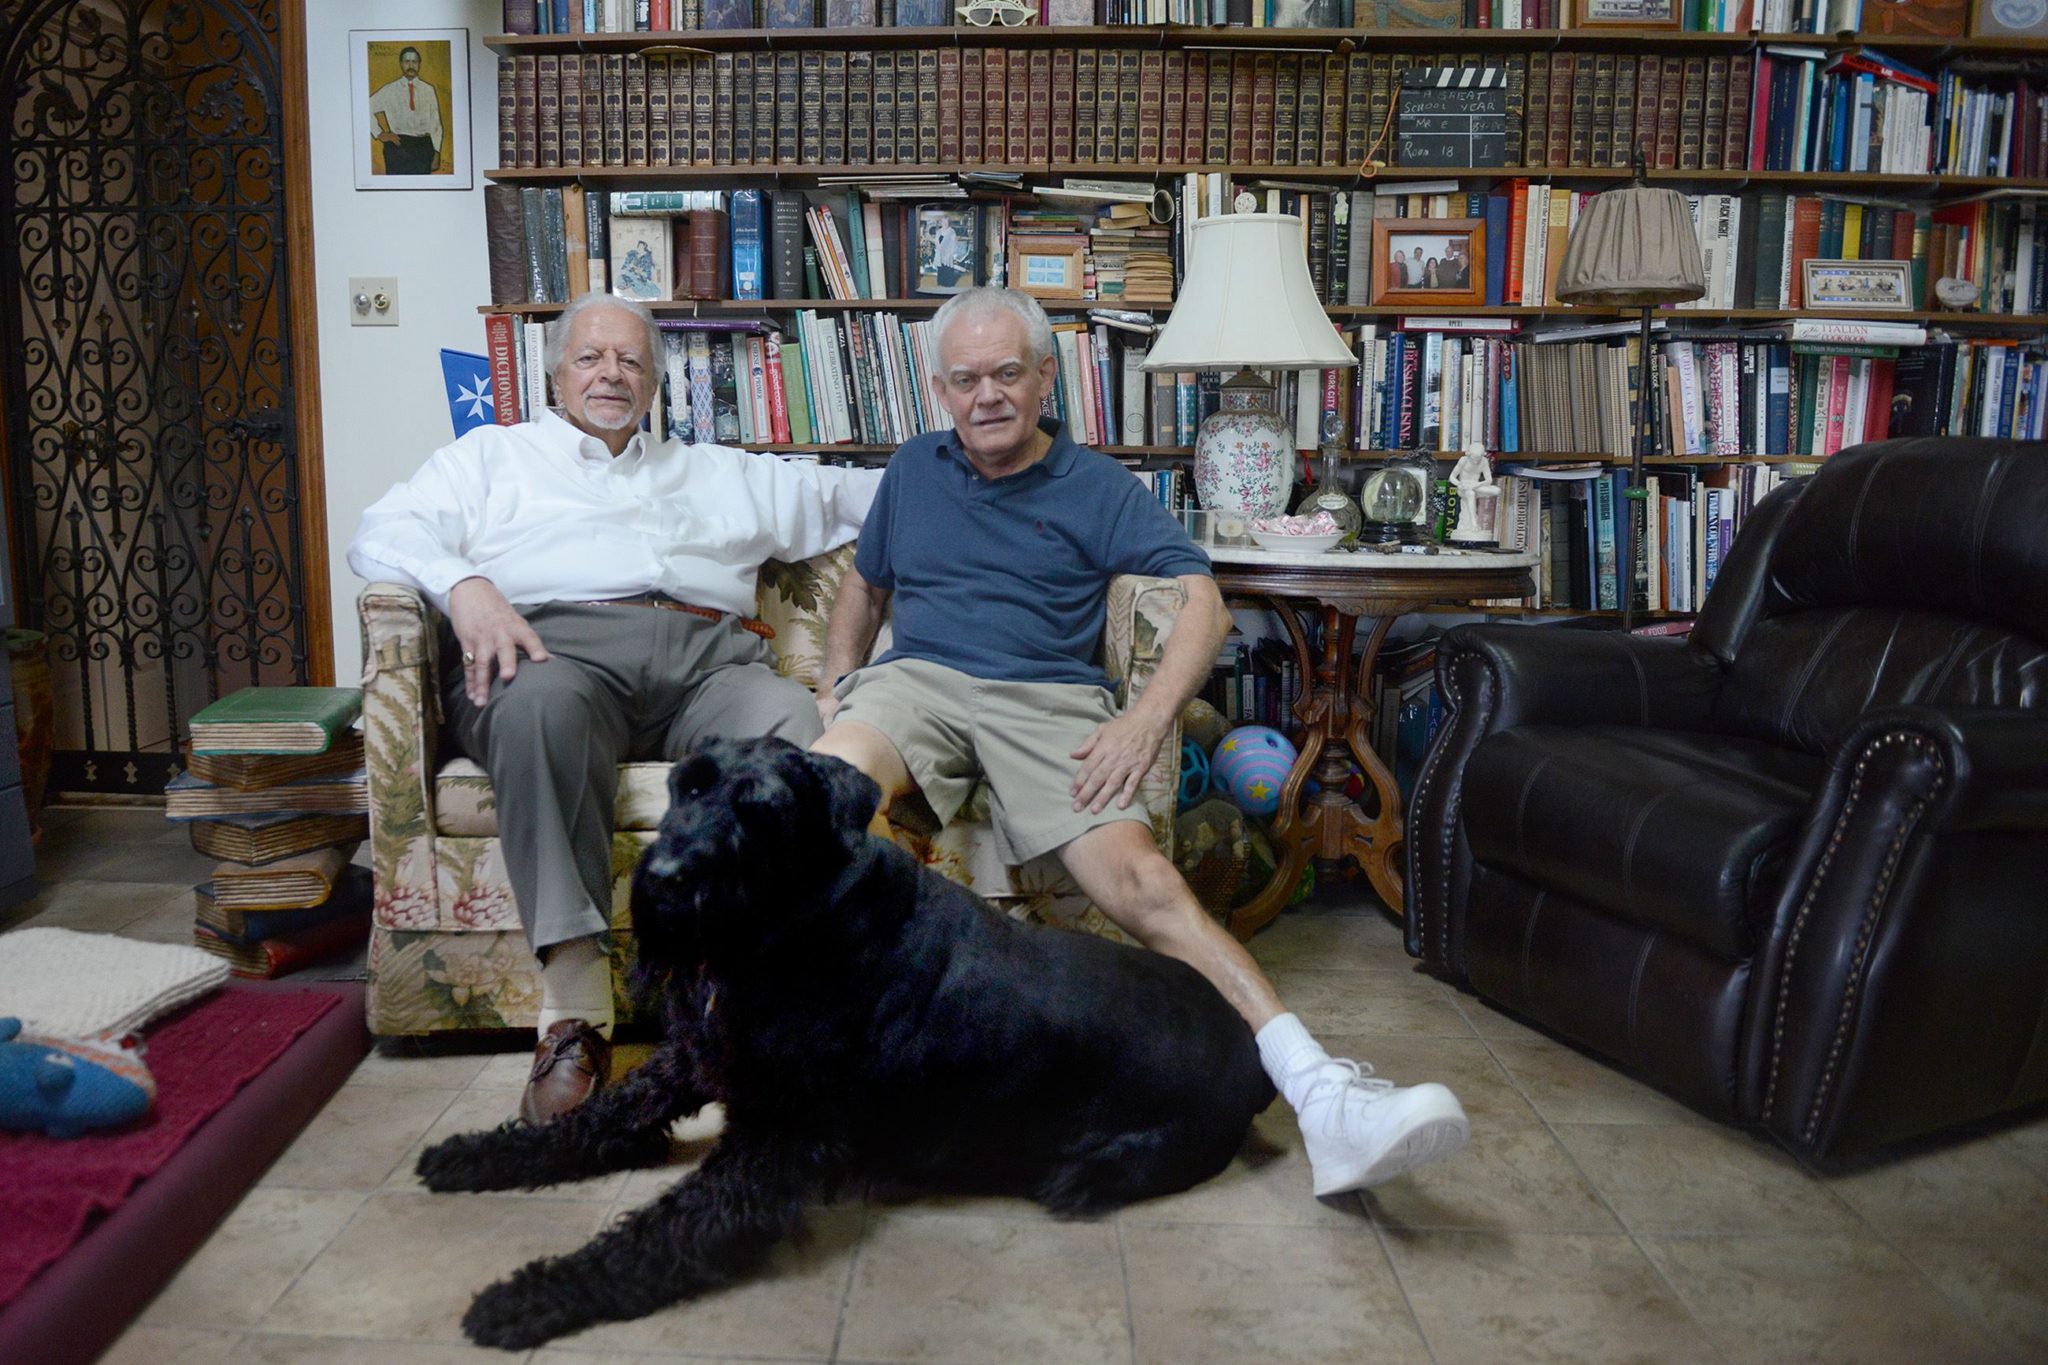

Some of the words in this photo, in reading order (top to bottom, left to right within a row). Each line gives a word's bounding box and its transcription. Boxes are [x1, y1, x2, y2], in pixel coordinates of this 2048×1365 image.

[1403, 101, 1447, 113] SCHOOL
[1461, 102, 1496, 112] YEAR
[1423, 90, 1432, 99] A
[1438, 90, 1487, 101] GREAT
[1440, 120, 1449, 129] E
[1441, 144, 1455, 158] 18
[1719, 197, 1731, 218] BLACK
[751, 342, 761, 367] CHEESE
[826, 335, 841, 390] CELEBRATING
[1402, 350, 1416, 394] RUSSIAN
[1652, 372, 1660, 389] Book
[493, 346, 514, 425] DICTIONARY
[754, 376, 764, 400] PRIMER
[1400, 394, 1413, 441] CUISINE
[1600, 482, 1611, 521] PITTSBURGH
[1708, 493, 1719, 526] ITALIAN
[1516, 480, 1529, 551] PSYCHOBIOLOGY
